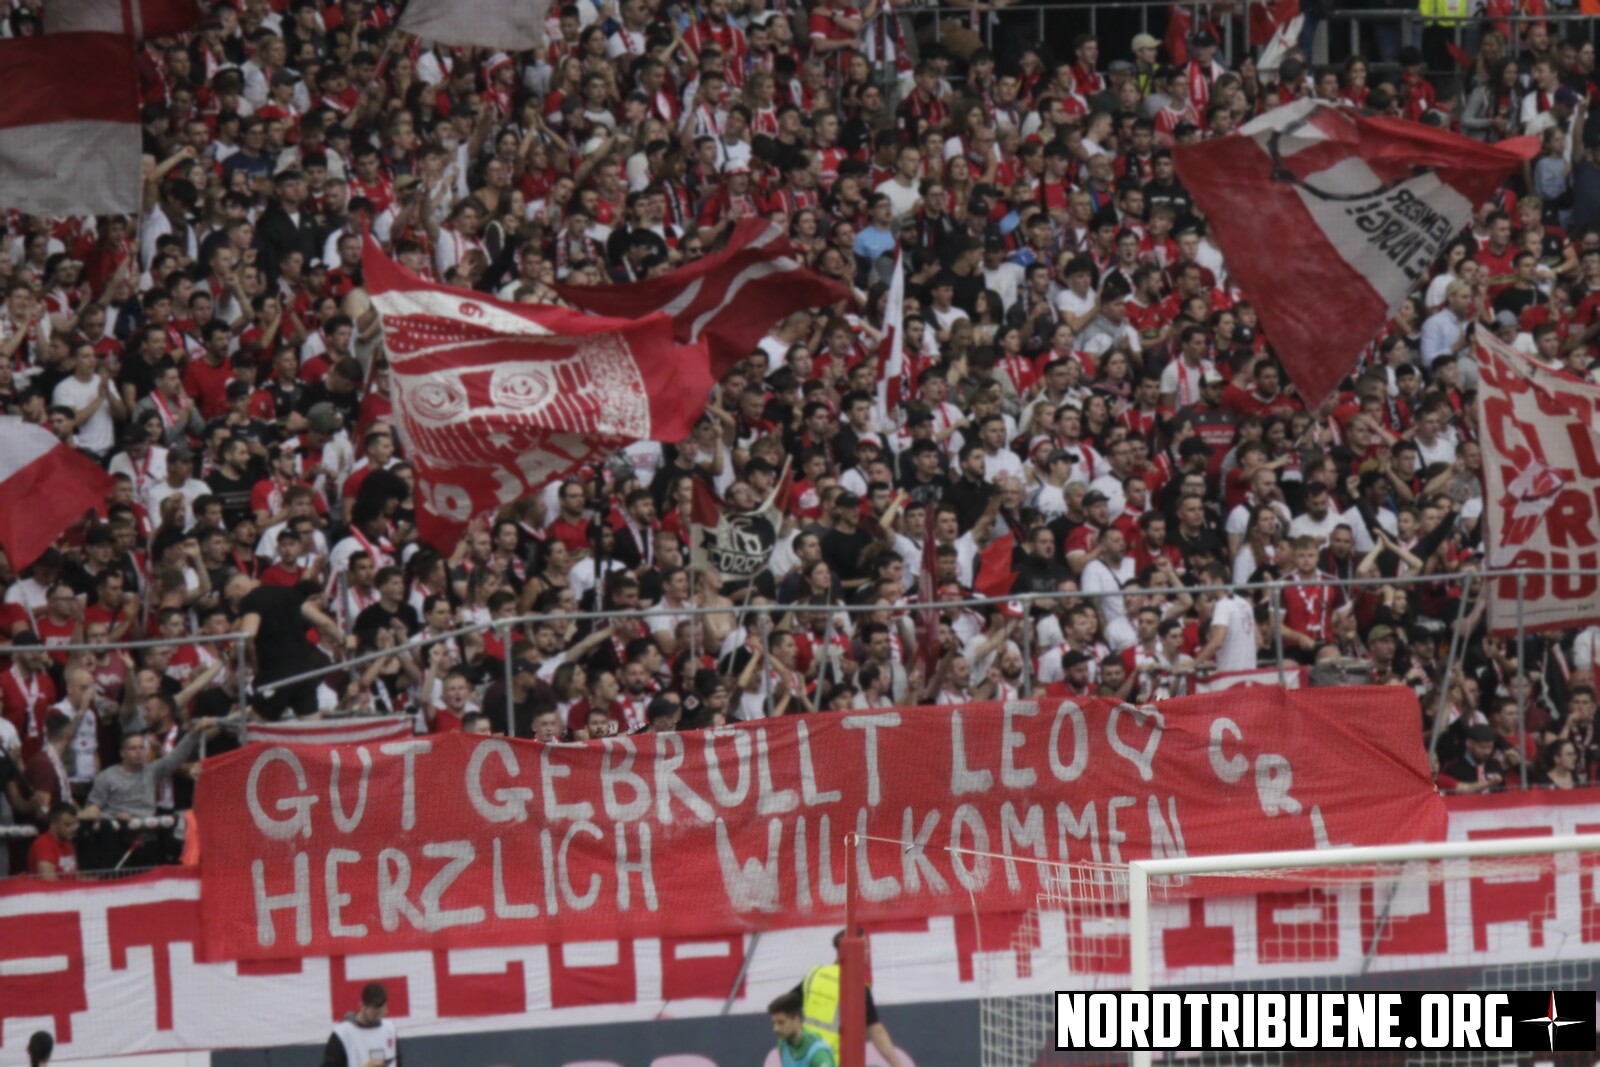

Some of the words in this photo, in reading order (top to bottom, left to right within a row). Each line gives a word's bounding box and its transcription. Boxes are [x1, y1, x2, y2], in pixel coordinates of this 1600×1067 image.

[246, 740, 433, 839] GUT
[950, 701, 1090, 796] LEO
[251, 820, 660, 947] HERZLICH
[714, 795, 1190, 914] WILLKOMMEN
